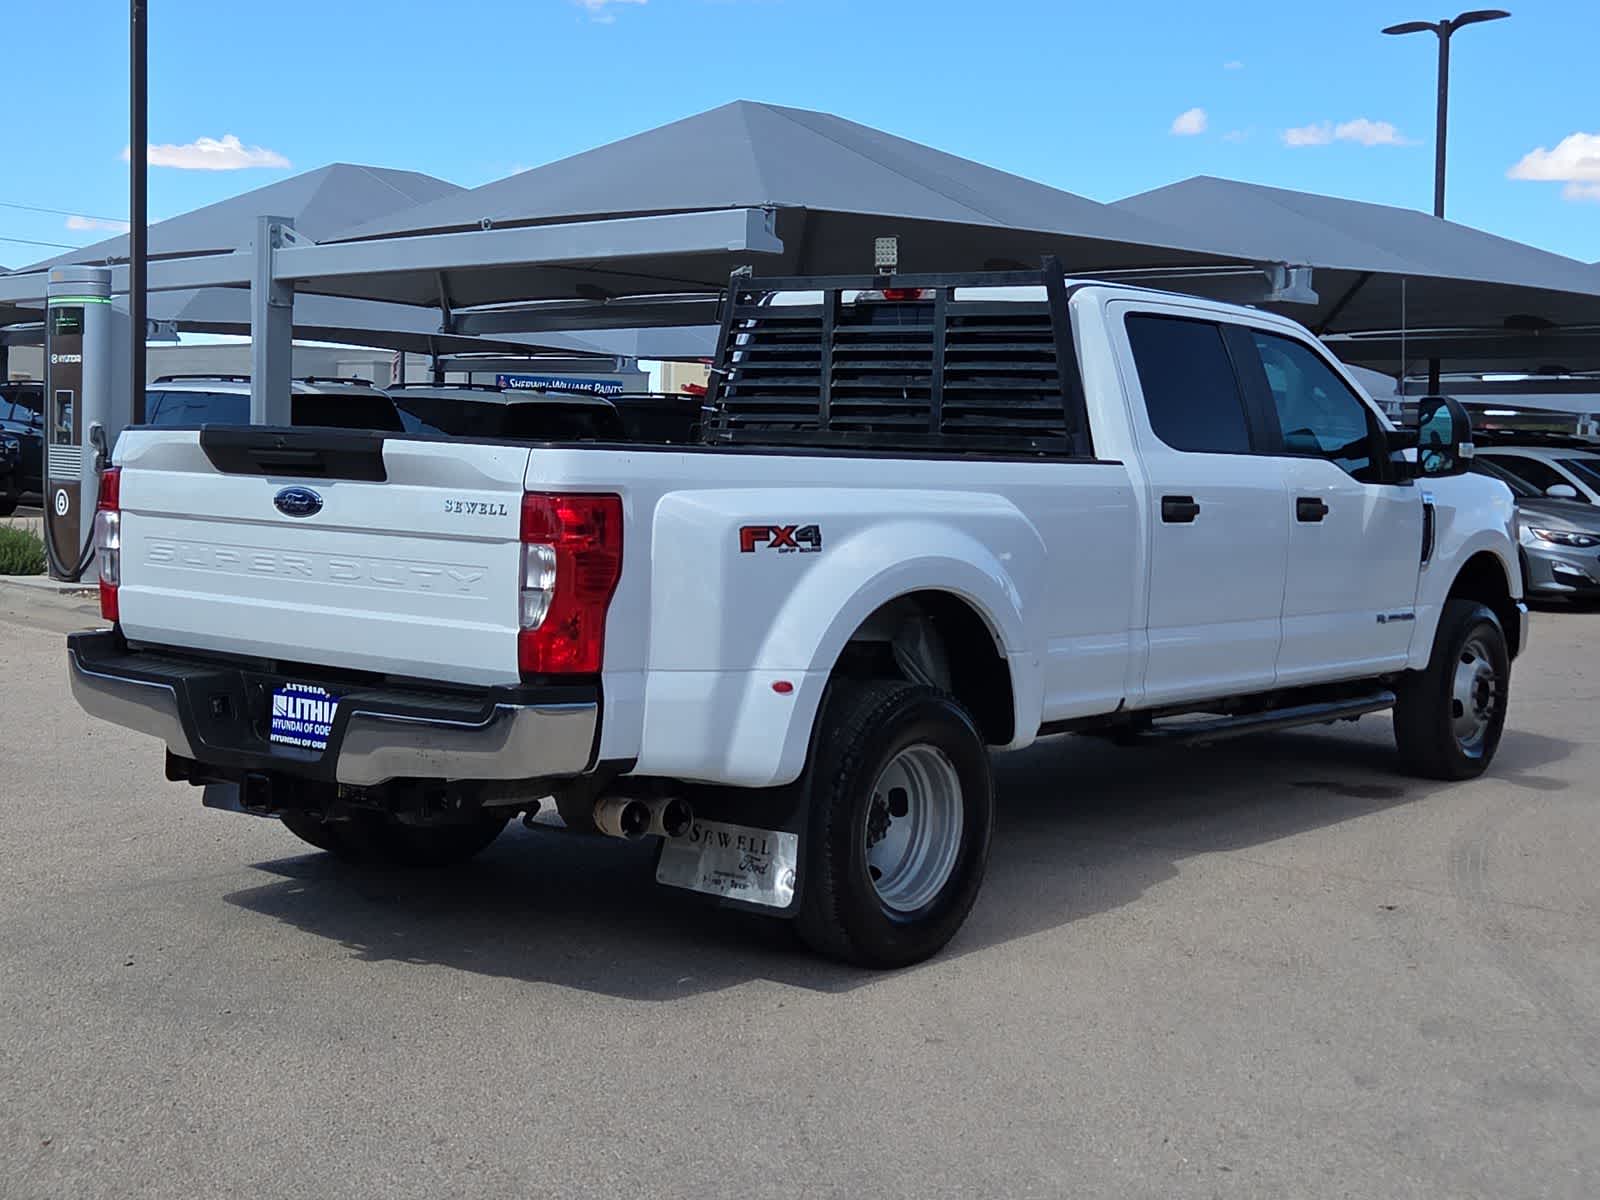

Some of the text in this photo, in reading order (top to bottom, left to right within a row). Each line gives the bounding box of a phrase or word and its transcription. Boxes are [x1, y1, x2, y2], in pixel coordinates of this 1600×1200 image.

[594, 383, 623, 394] PAINTS
[444, 499, 508, 516] SEWELL
[739, 524, 822, 553] FX4
[148, 543, 485, 593] SUPER DUTY
[286, 682, 326, 695] LITHIA
[272, 718, 303, 732] HYUNDAI
[303, 722, 314, 733] OF
[270, 733, 301, 745] HYUNDAI
[301, 738, 312, 747] OF
[689, 823, 770, 856] SEWELL
[738, 853, 769, 875] Ford
